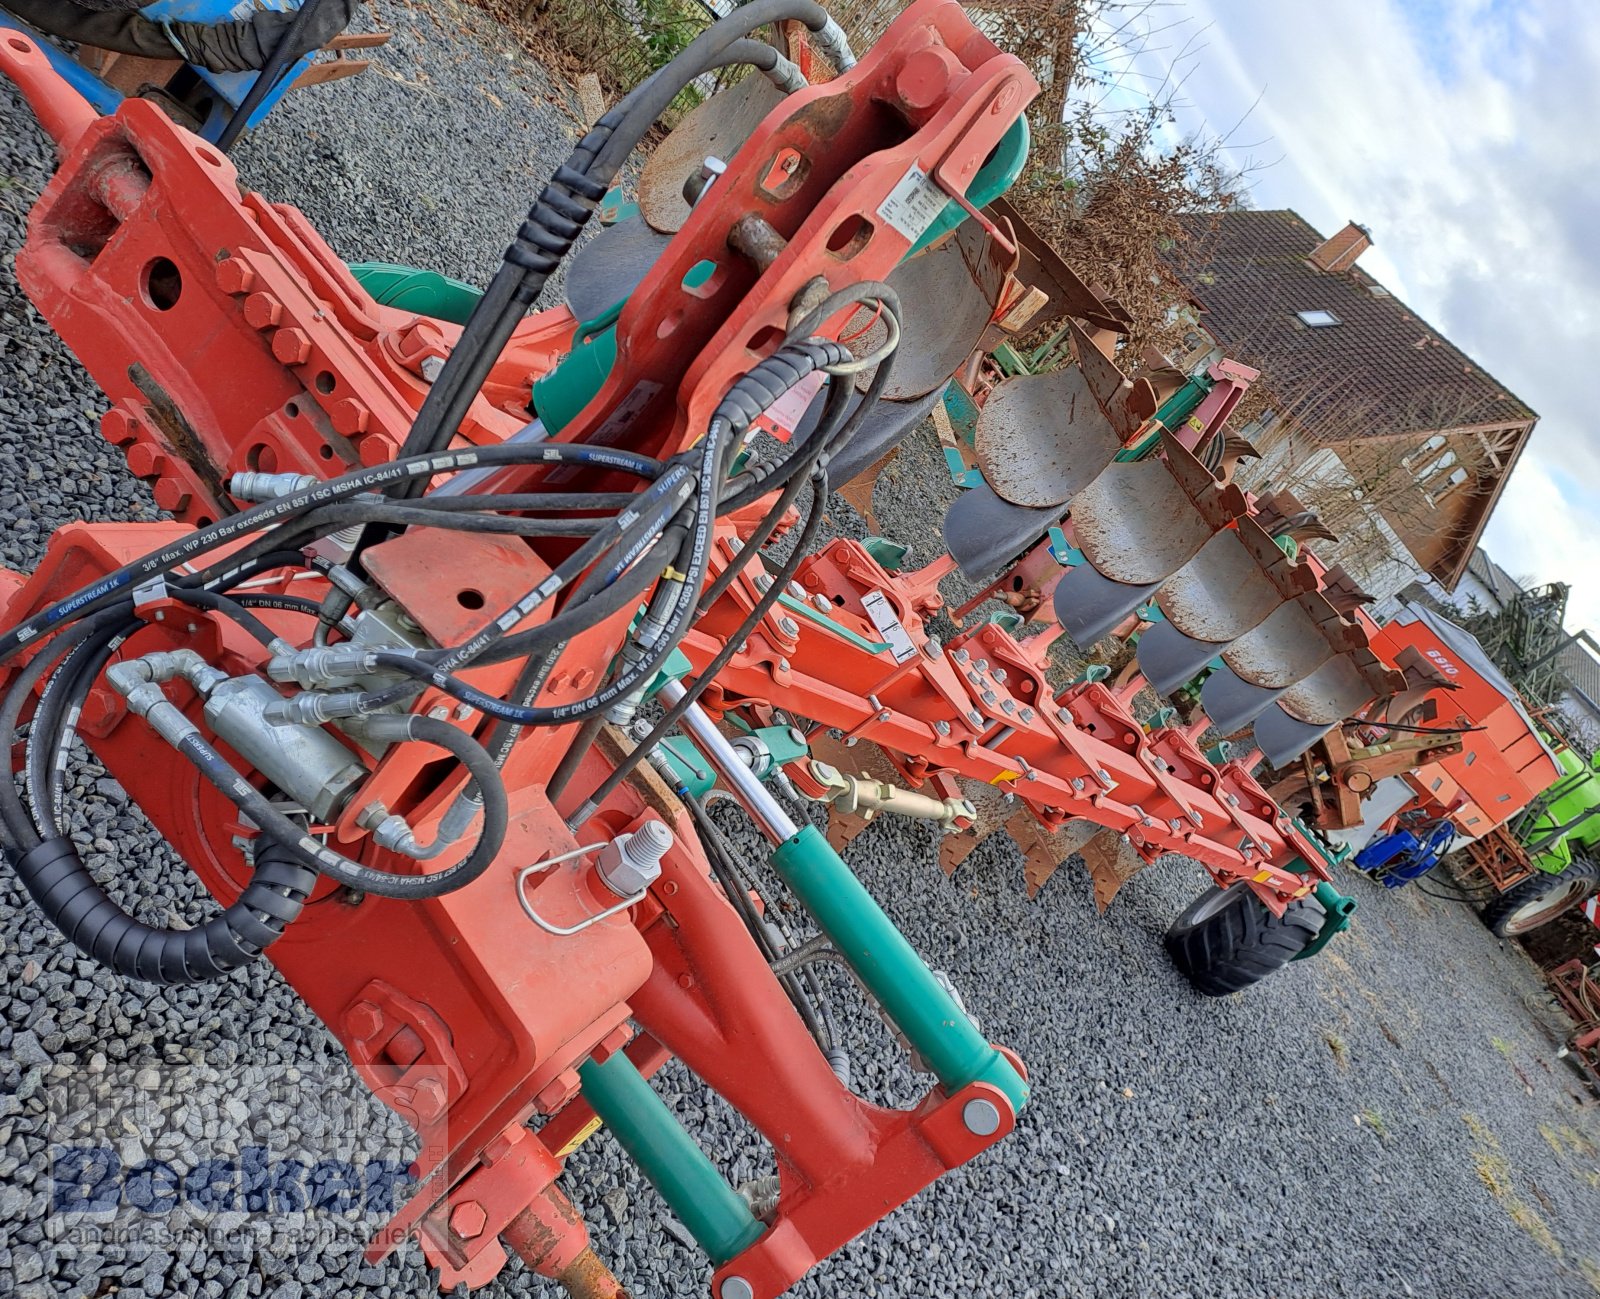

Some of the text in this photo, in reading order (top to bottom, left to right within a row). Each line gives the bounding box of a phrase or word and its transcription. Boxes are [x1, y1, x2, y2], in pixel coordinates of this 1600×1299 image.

[588, 452, 636, 470] SUPERSTREAM
[703, 449, 714, 475] MSHA
[701, 475, 712, 492] 1SC
[617, 464, 690, 530] SEL SUPERS
[700, 494, 710, 510] 857
[698, 510, 708, 524] EN
[17, 626, 38, 642] SEL
[58, 583, 109, 616] SUPERSTREAM
[162, 548, 184, 564] Max.
[184, 540, 200, 553] WP
[200, 531, 218, 545] 230
[218, 524, 236, 538] Bar
[236, 508, 276, 530] exceeds
[276, 501, 292, 514] EN
[292, 495, 310, 508] 857
[311, 488, 332, 502] 1SC
[332, 479, 363, 494] MSHA
[364, 468, 402, 485] IC-84/41
[692, 525, 707, 565] EXCEED
[686, 564, 700, 584] PSI
[678, 584, 694, 608] 4205
[664, 615, 682, 632] Bar
[108, 634, 126, 651] SEL
[654, 632, 670, 652] 290
[438, 634, 491, 673] SHA IC-84/41
[616, 672, 639, 692] Max.
[587, 698, 599, 708] 06
[599, 689, 616, 702] mm
[572, 702, 586, 714] DN
[186, 734, 252, 796] SEL SUPERST
[54, 783, 63, 837] SHA IC-84/41
